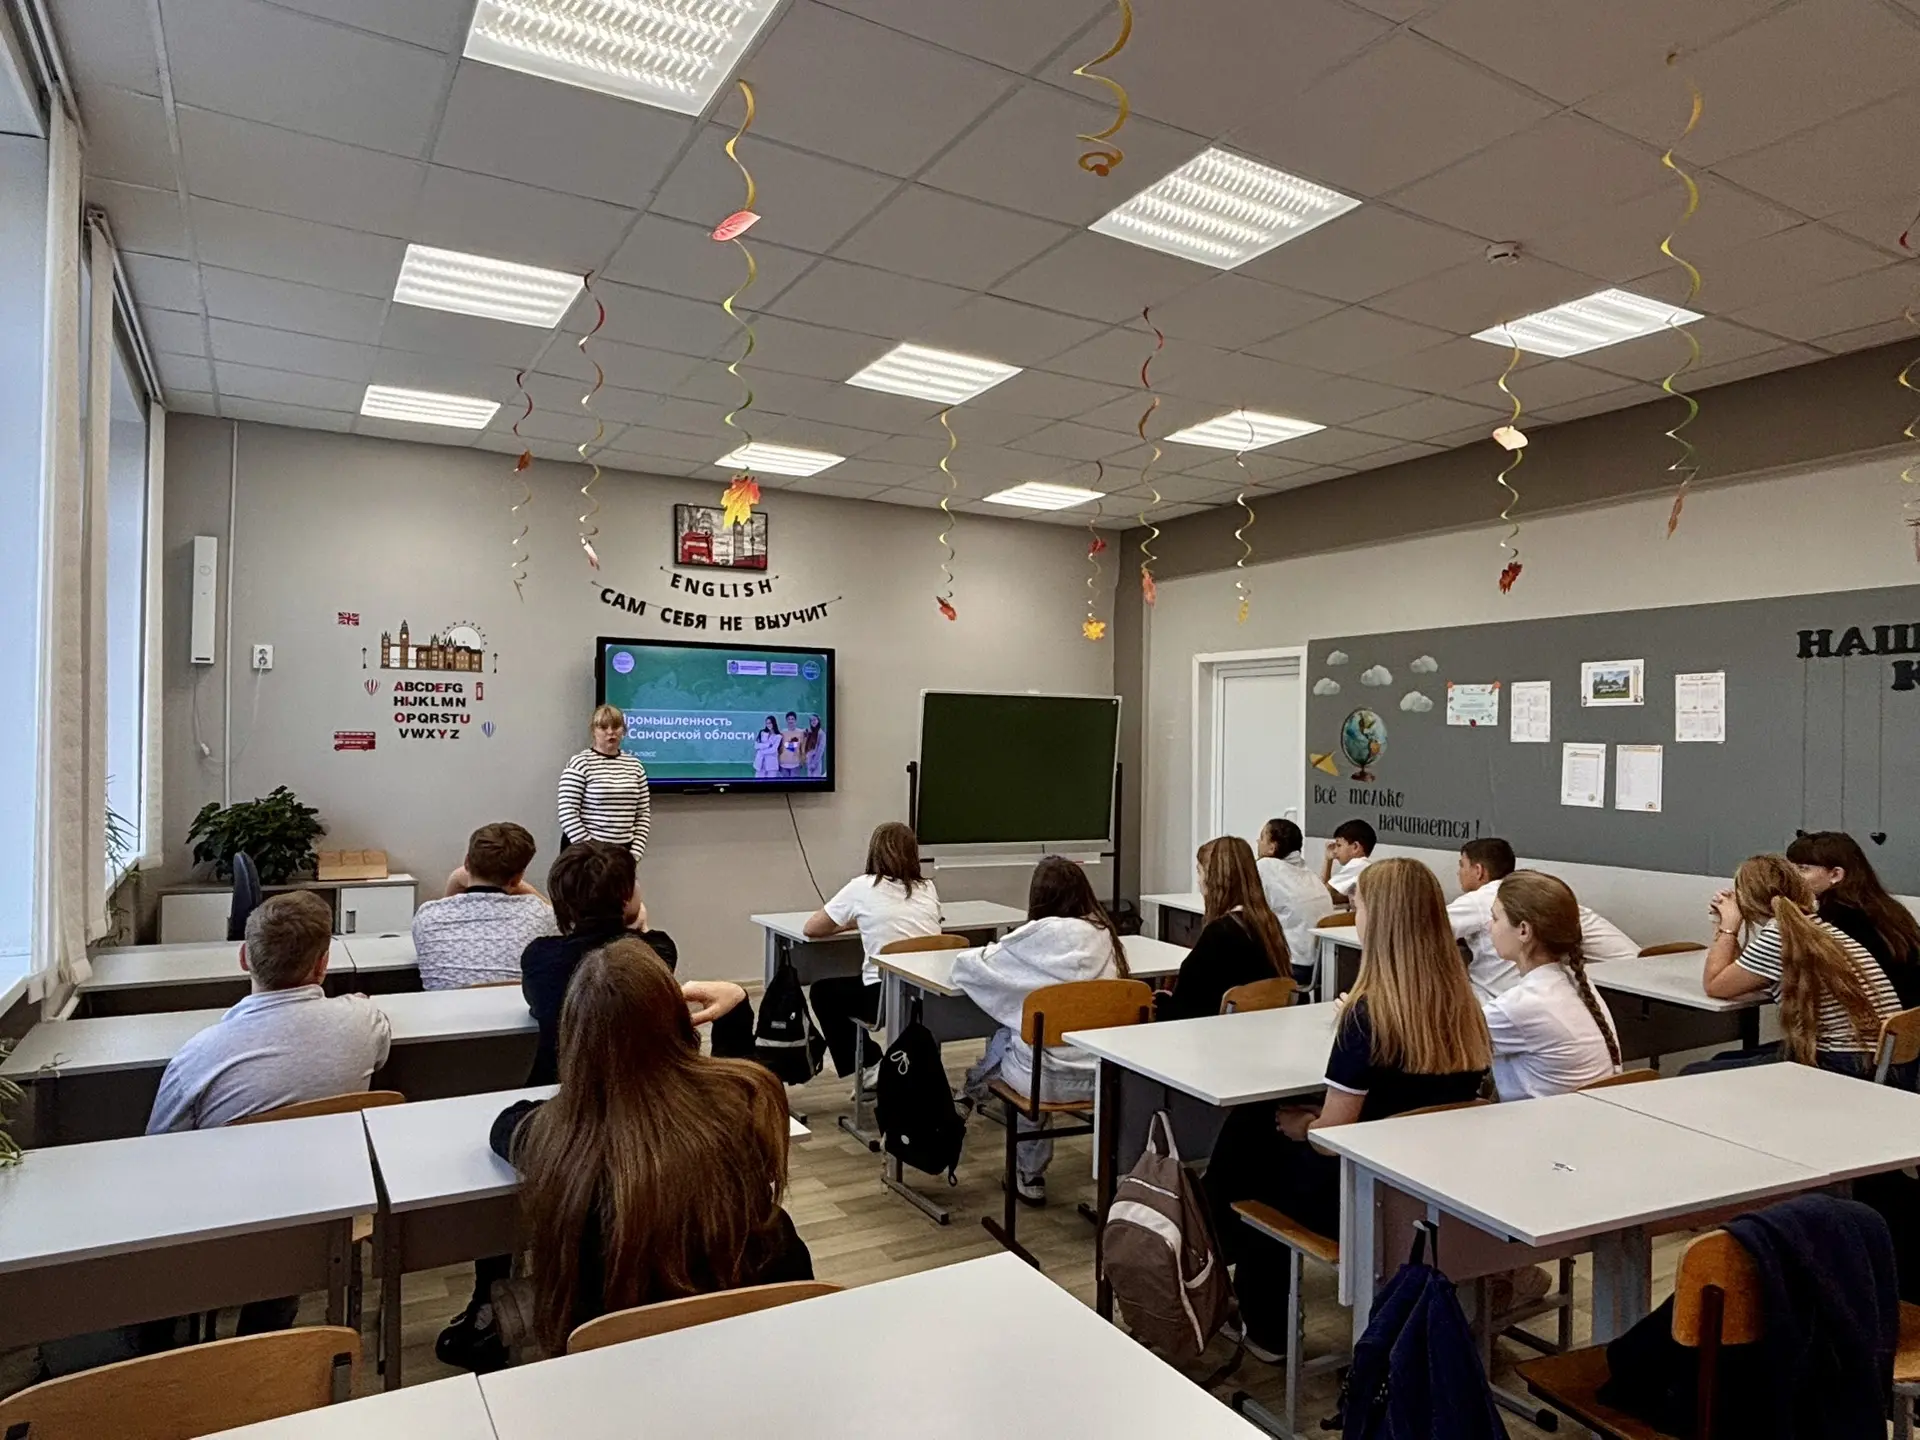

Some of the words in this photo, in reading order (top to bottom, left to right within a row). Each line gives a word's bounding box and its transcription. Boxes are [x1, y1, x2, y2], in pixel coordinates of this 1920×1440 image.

[670, 572, 773, 598] ENGLISH
[600, 588, 647, 616] САМ
[660, 606, 707, 629] СЕБЯ
[719, 616, 743, 631] НЕ
[754, 602, 829, 631] ВЫУЧИТ
[393, 681, 463, 693] ABCDEFG
[393, 696, 466, 708] HIJKLMN
[394, 712, 471, 724] OPQRSTU
[628, 728, 701, 743] Самарской
[704, 729, 755, 741] области
[1349, 787, 1405, 809] только
